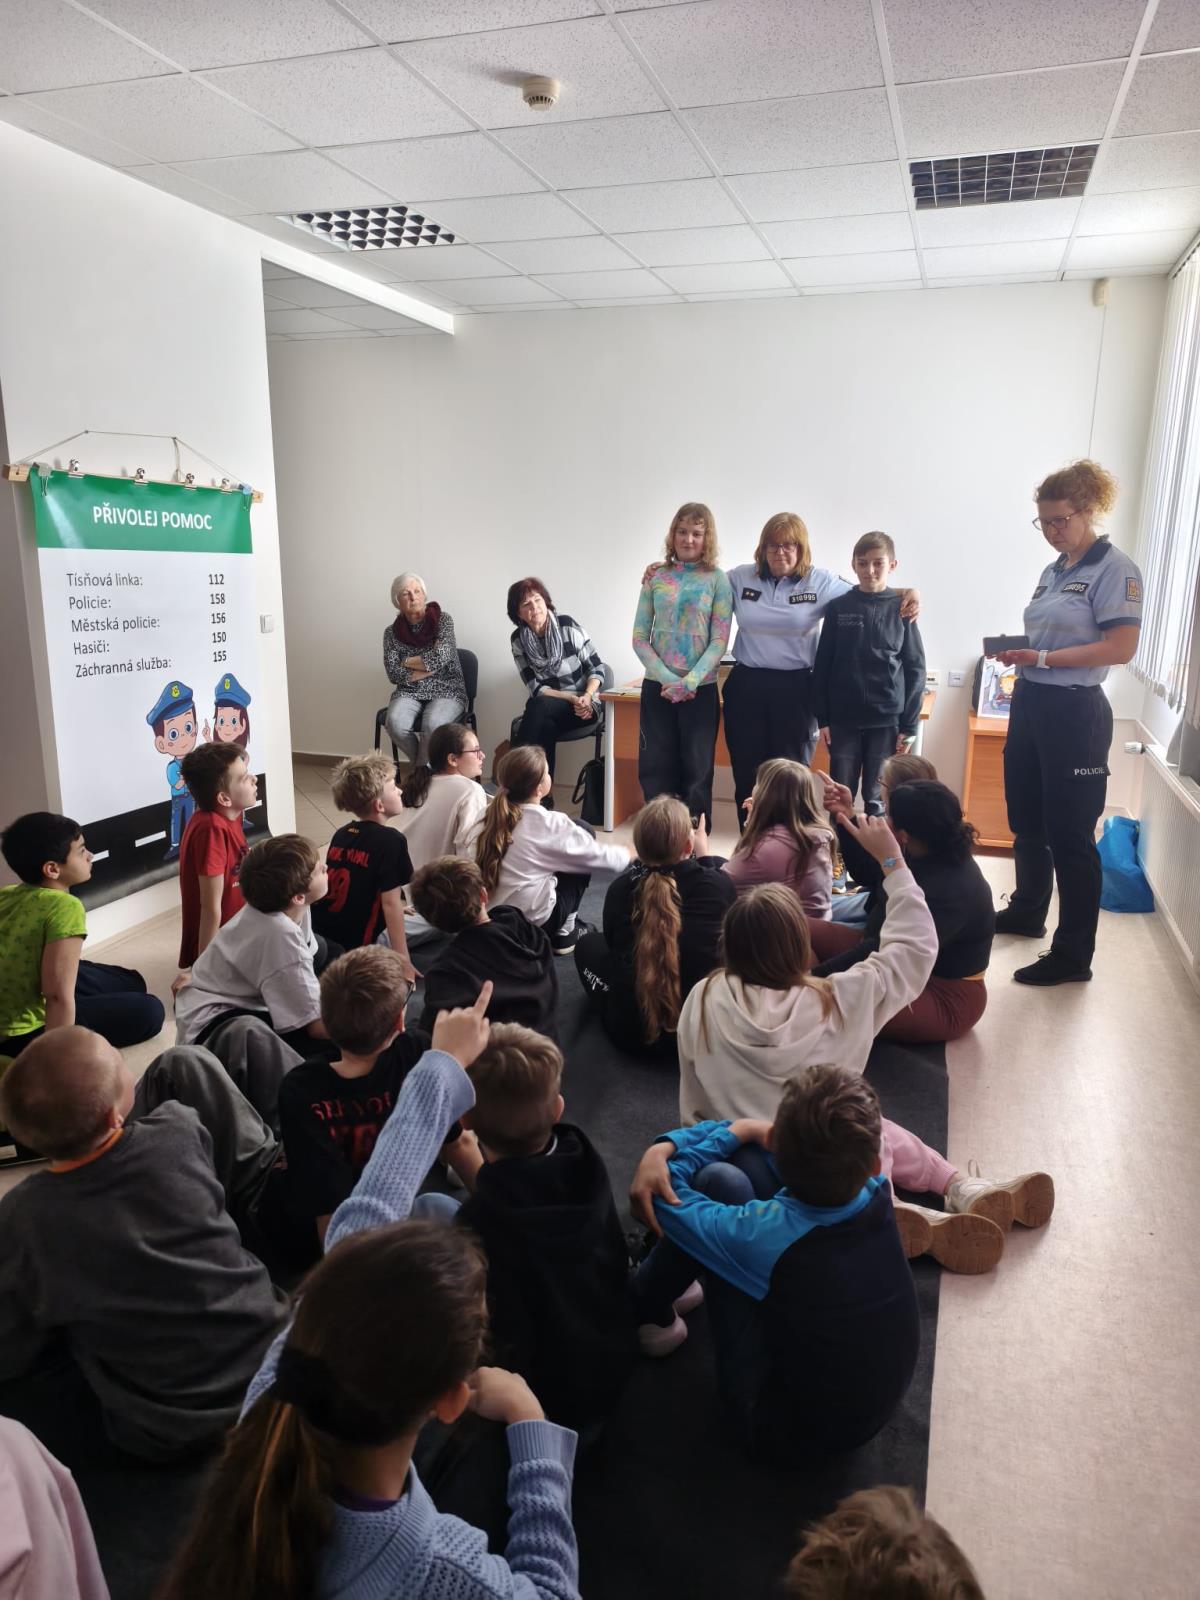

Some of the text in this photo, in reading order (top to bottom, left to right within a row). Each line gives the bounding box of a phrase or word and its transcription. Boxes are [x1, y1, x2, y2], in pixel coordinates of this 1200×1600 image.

[93, 502, 213, 530] PŘIVOLEJ POMOC
[66, 573, 224, 587] Tísňová linka: 112
[69, 593, 225, 609] Policie: 158
[71, 612, 226, 632] Městská policie: 156
[73, 631, 227, 655] Hasiči: 150
[75, 650, 227, 678] Záchranná služba: 155
